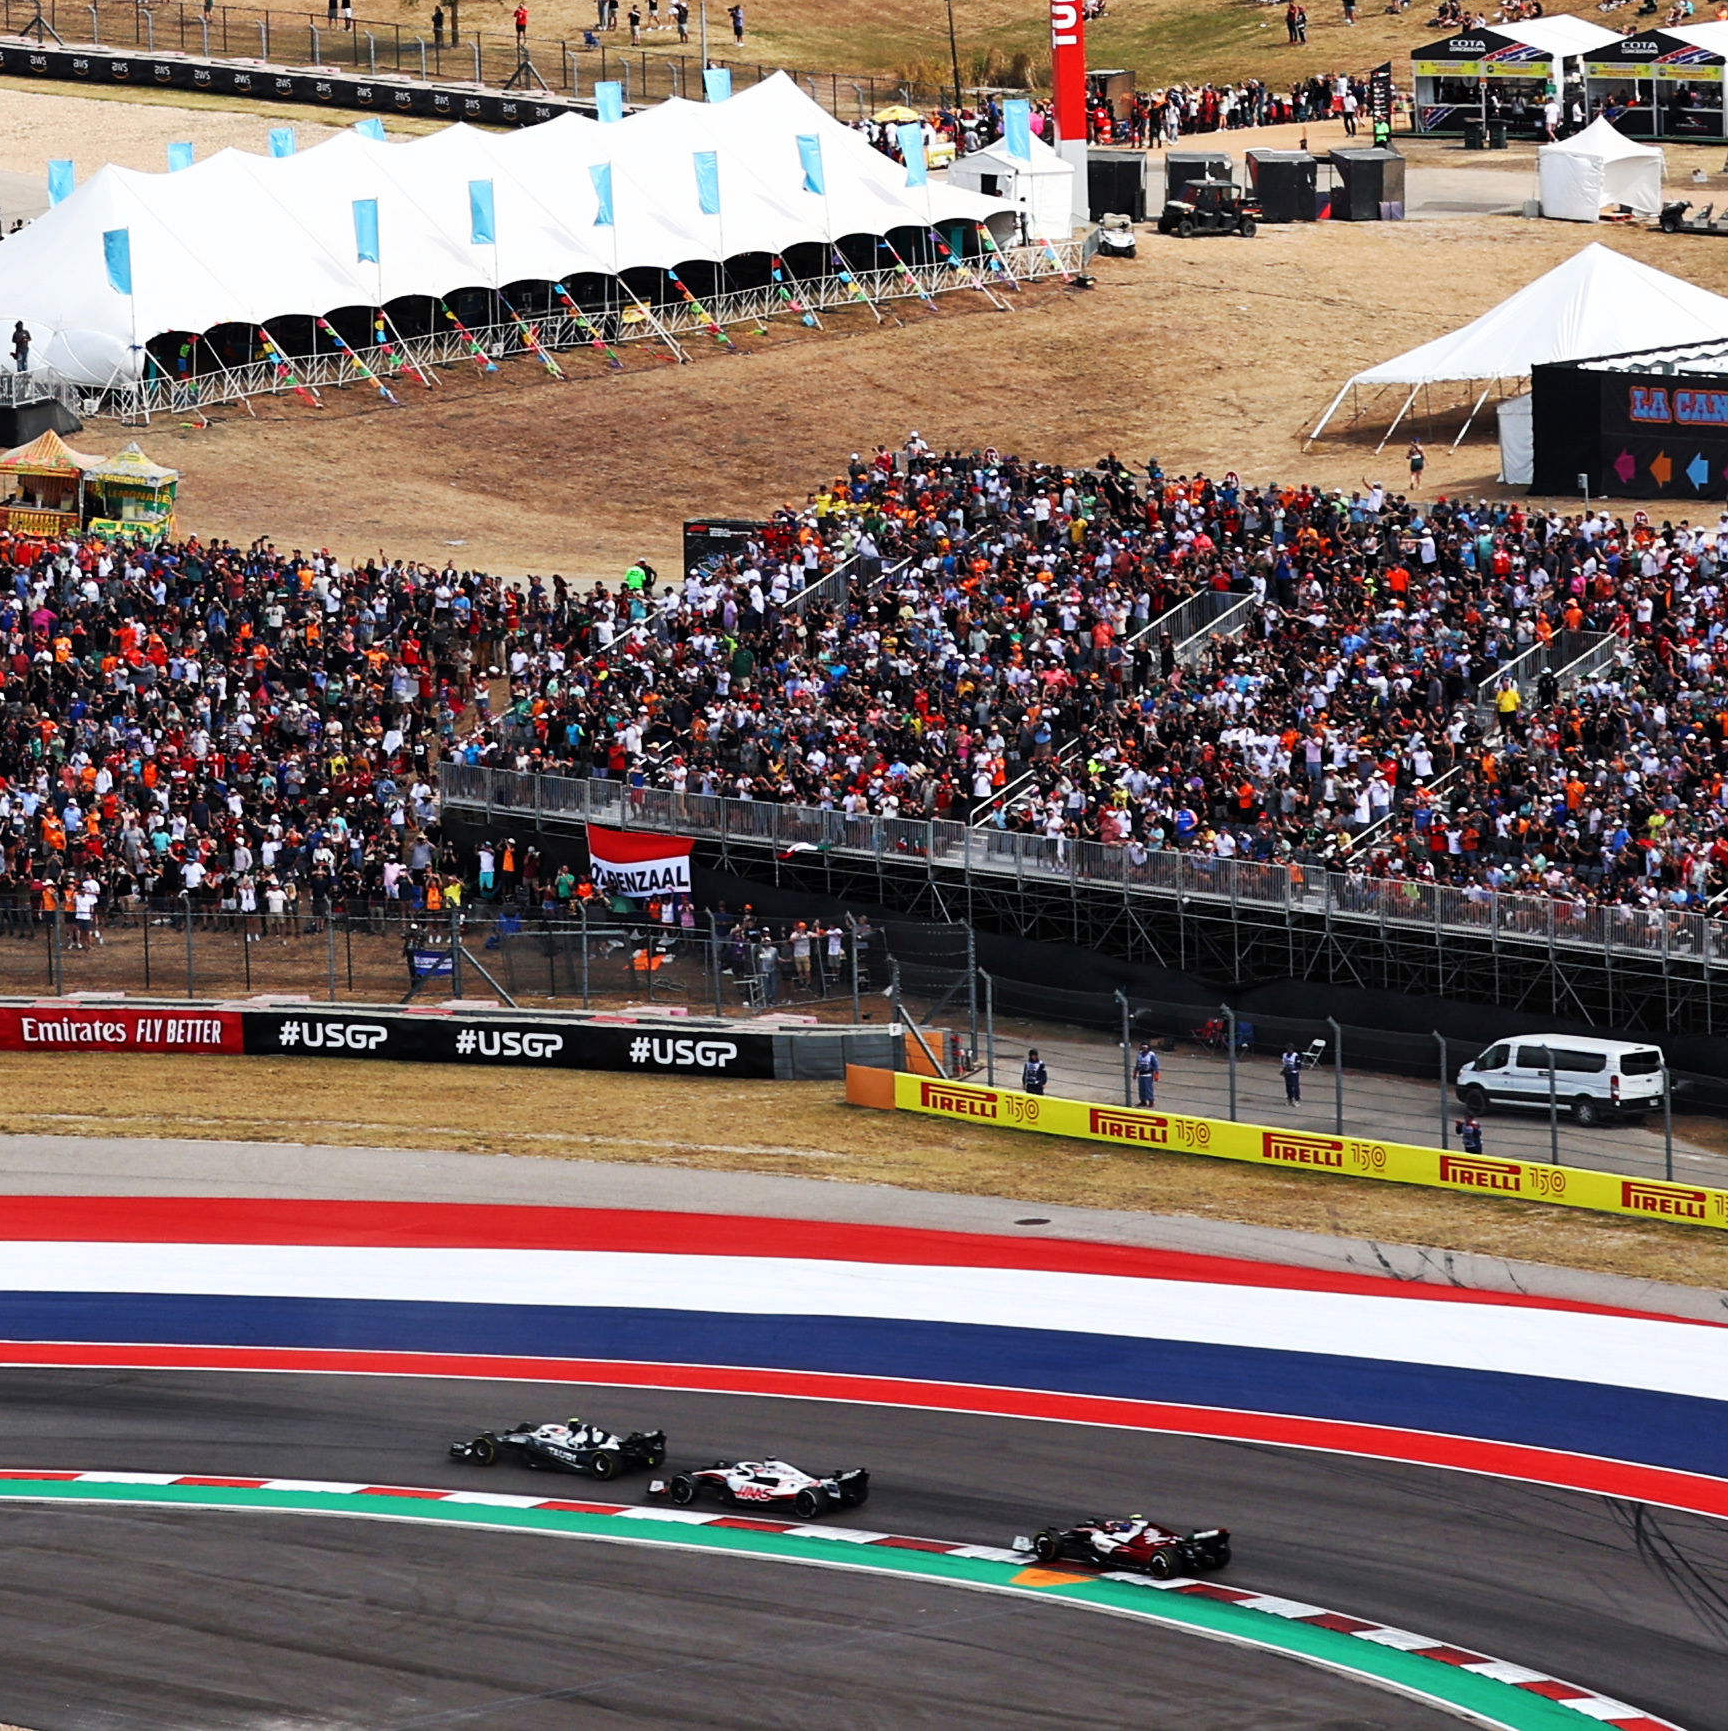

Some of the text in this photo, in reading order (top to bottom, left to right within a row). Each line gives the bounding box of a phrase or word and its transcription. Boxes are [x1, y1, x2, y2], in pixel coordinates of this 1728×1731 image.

[1449, 39, 1486, 48] COTA
[1621, 41, 1658, 49] COTA
[1630, 386, 1672, 423] LA
[22, 1018, 220, 1043] Emirates FLY BETTER
[279, 1021, 387, 1049] #USGP
[456, 1030, 562, 1057] #USGP
[630, 1037, 737, 1067] #USGP
[921, 1082, 1040, 1123] PIRELLI 150
[1090, 1108, 1211, 1147] PIRELLI 150
[1262, 1132, 1387, 1171] PIRELLI 150
[1440, 1155, 1567, 1195] PIRELLI 150
[1622, 1181, 1707, 1219] PIRELLI
[738, 1485, 772, 1500] HAAS
